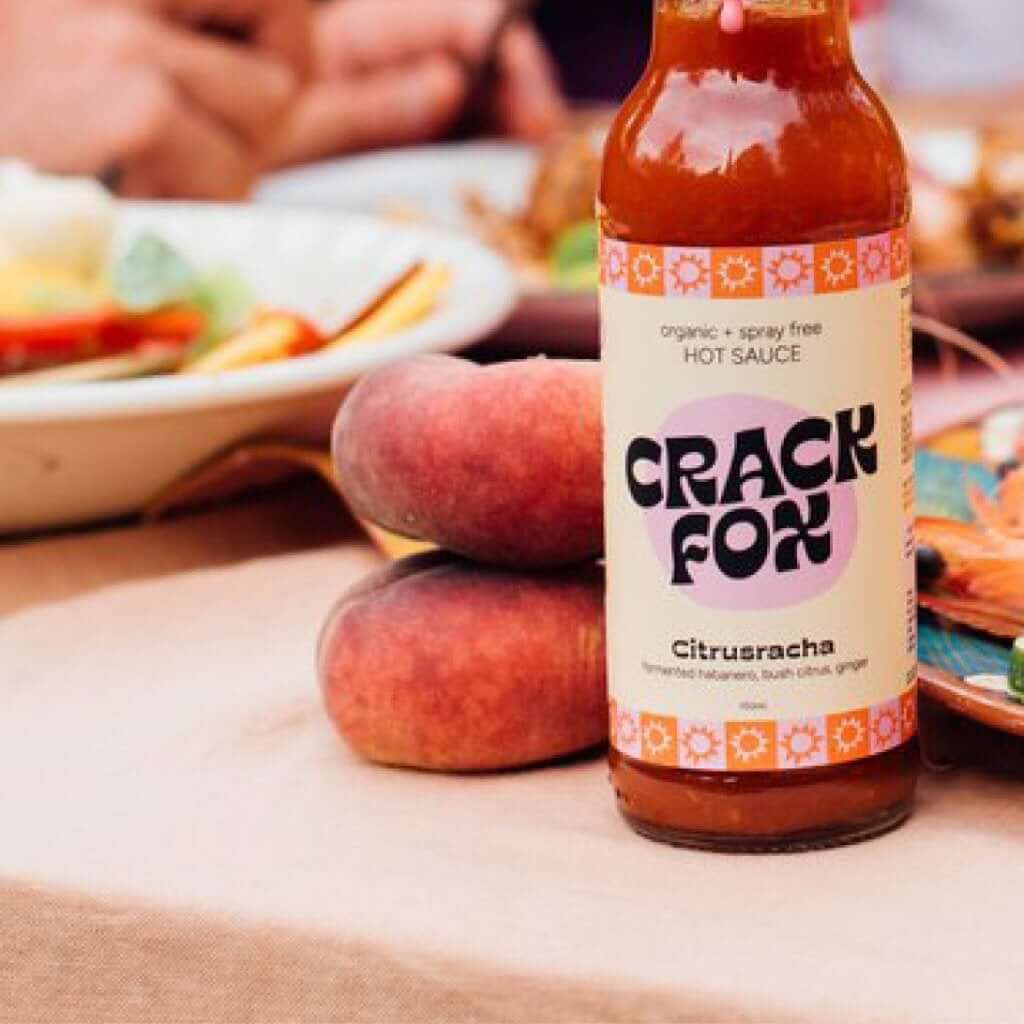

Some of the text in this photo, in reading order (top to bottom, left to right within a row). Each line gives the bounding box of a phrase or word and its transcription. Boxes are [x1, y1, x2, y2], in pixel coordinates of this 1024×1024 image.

[660, 320, 823, 342] organic + spray free
[684, 345, 801, 365] HOT SAUCE
[625, 403, 877, 509] CRACK
[671, 492, 831, 585] FOX
[671, 637, 835, 661] Citrusracha
